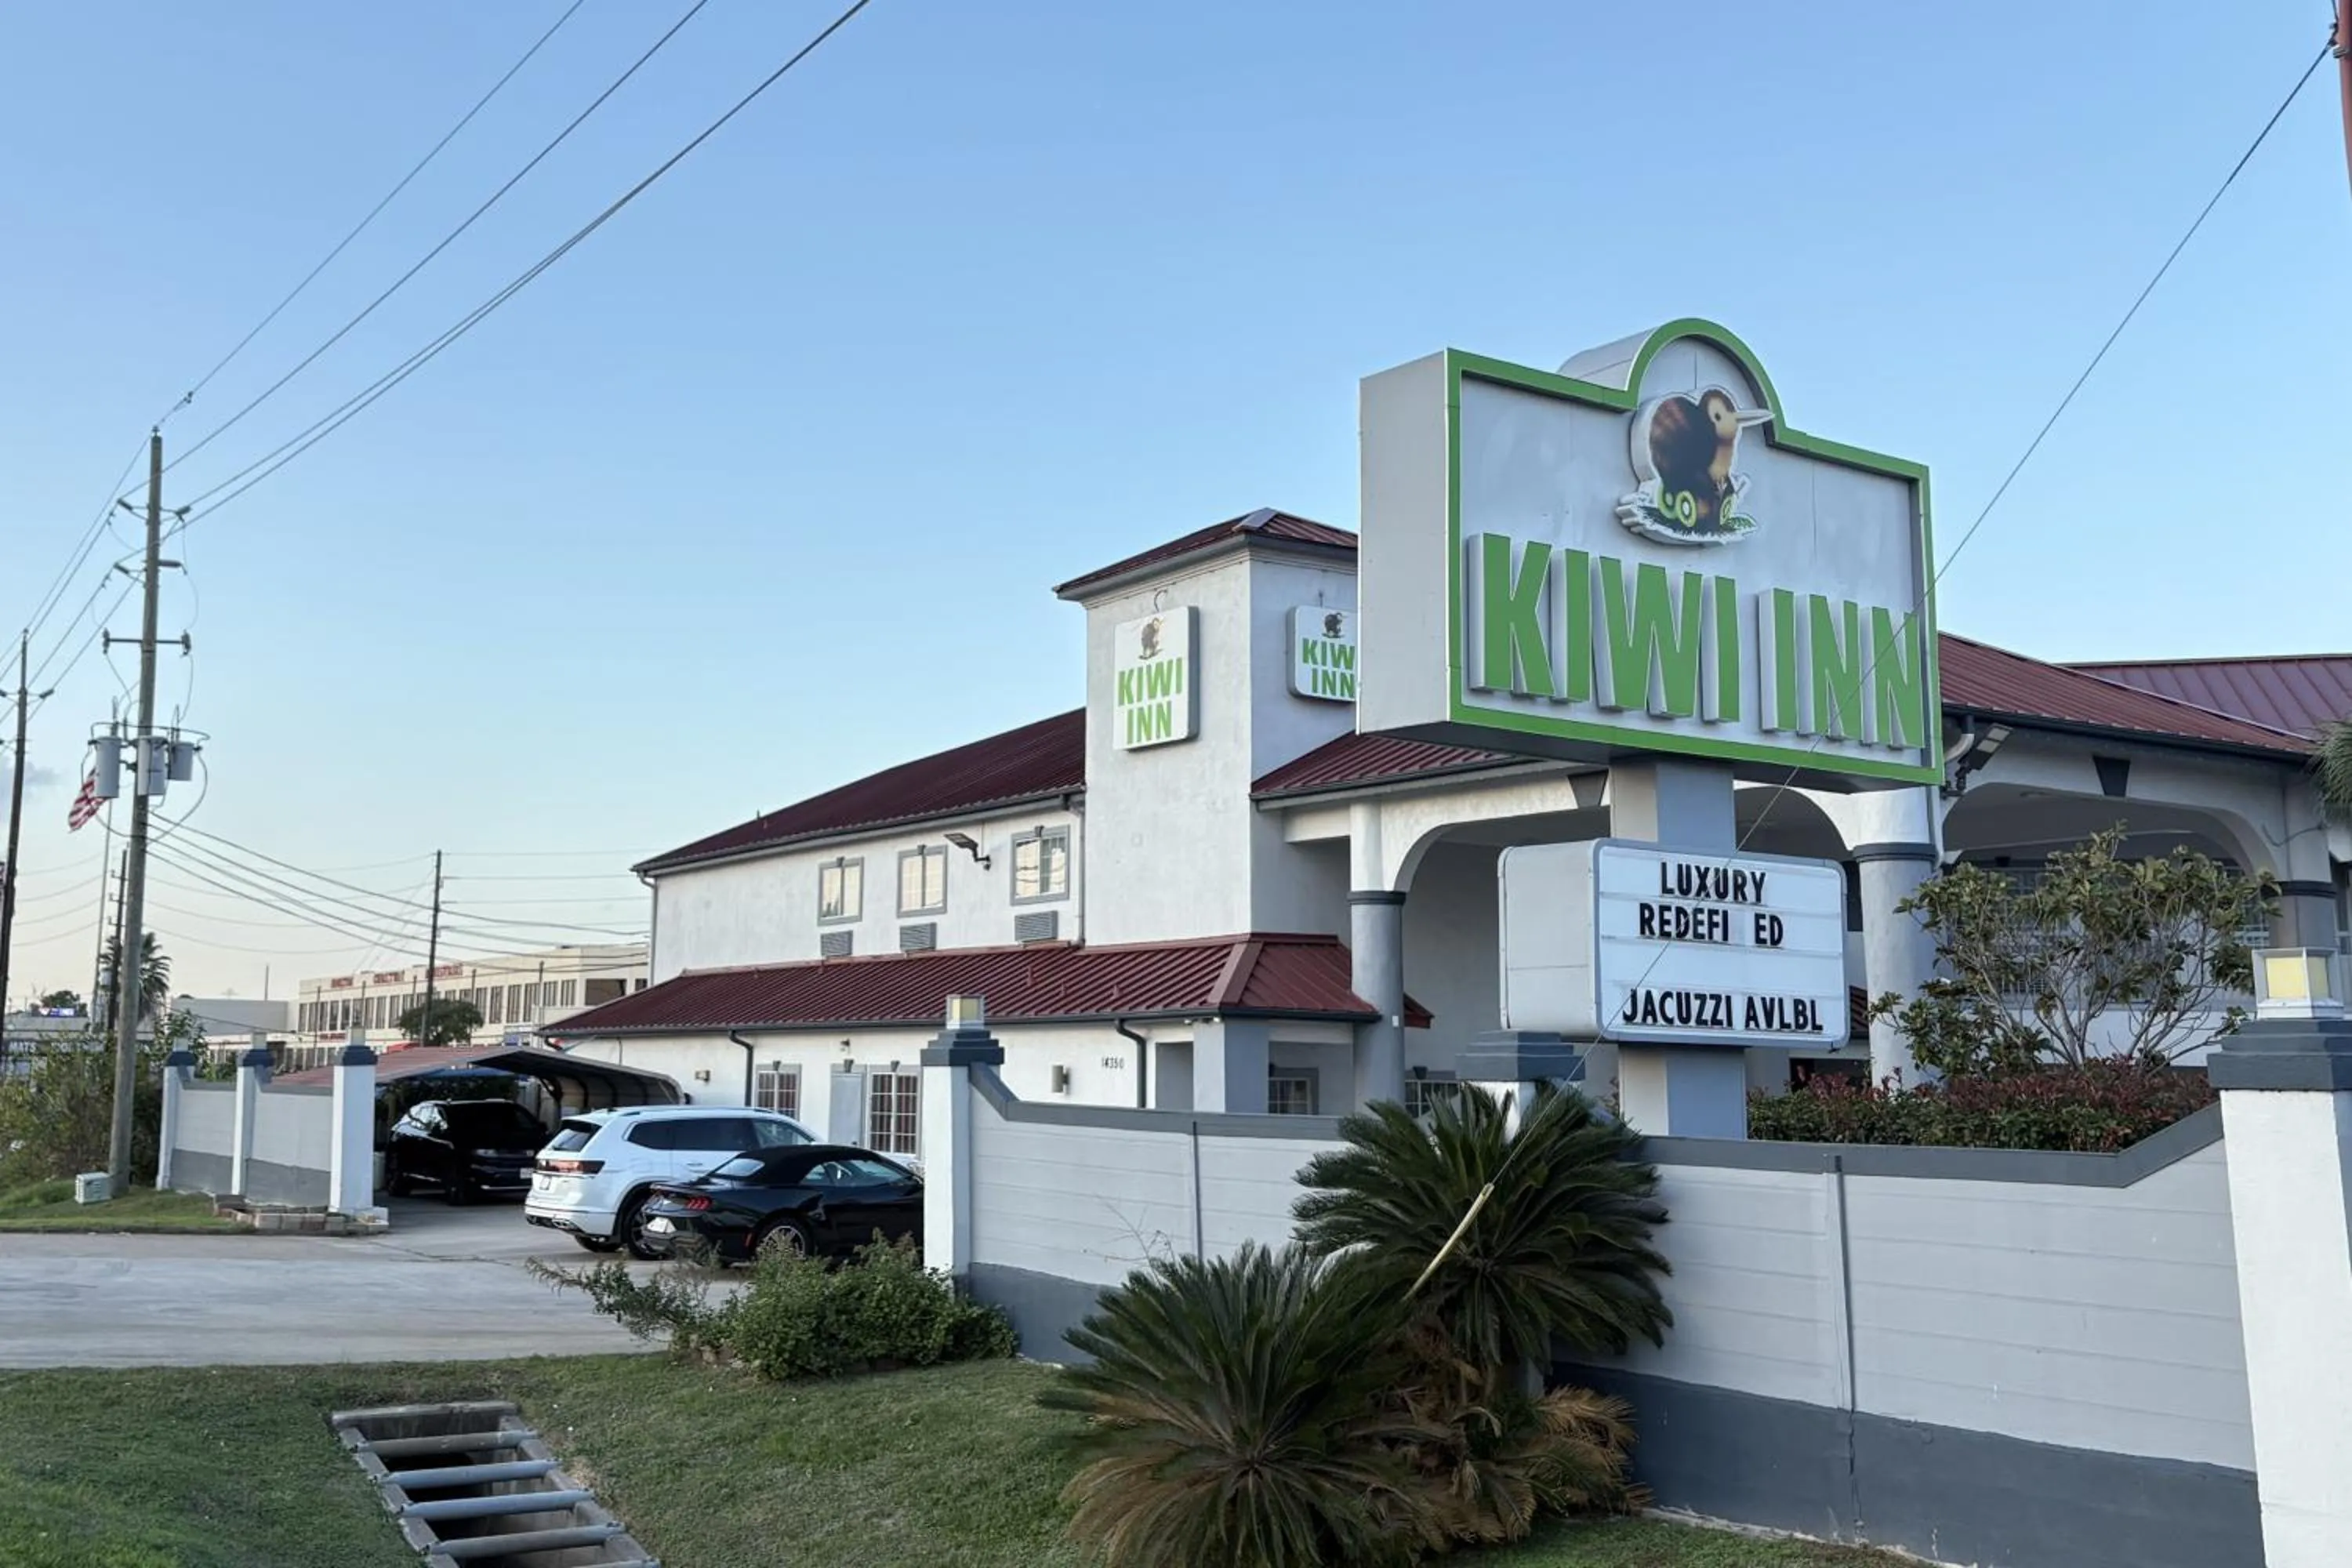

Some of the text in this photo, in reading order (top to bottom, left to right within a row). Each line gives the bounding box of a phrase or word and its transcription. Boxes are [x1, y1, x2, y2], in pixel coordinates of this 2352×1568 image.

[1302, 637, 1356, 670] KIW
[1474, 532, 1925, 750] KIWI INN
[1118, 657, 1183, 706] KIWI
[1312, 668, 1355, 699] INN
[1127, 701, 1172, 745] INN
[1661, 862, 1766, 903] LUXURY
[1622, 988, 1824, 1031] JACUZZI AVLBL
